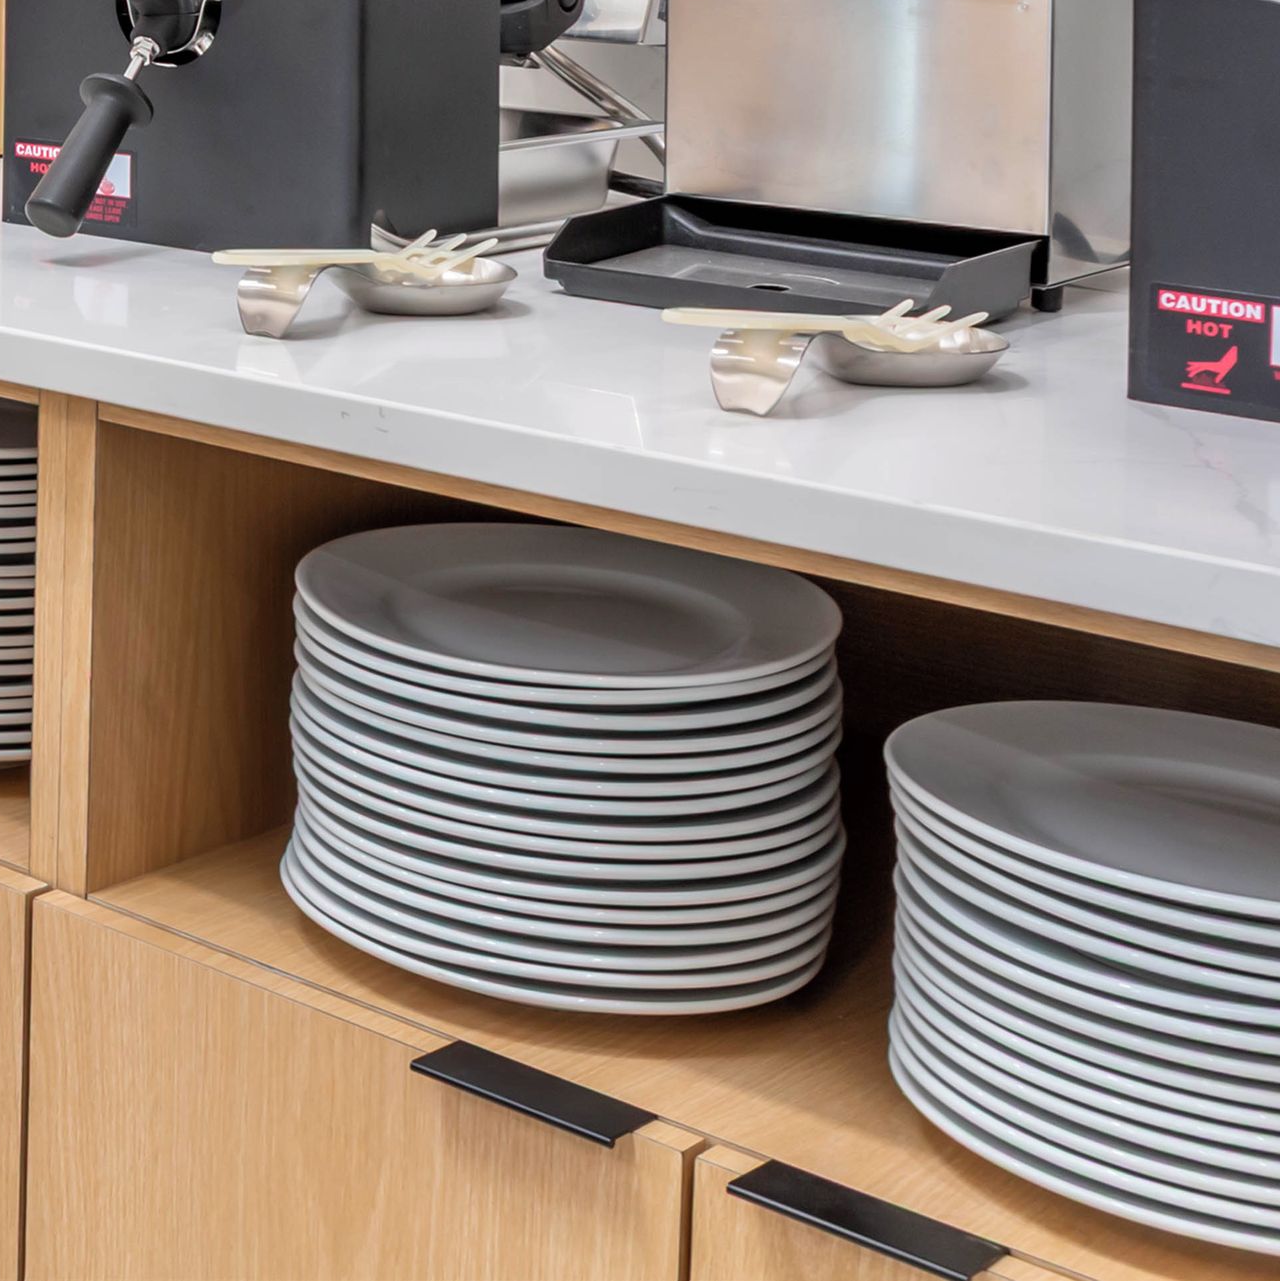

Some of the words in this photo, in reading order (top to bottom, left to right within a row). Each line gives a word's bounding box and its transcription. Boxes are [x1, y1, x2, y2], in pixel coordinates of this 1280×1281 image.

[16, 144, 60, 158] CAUTIO
[30, 161, 49, 175] HO
[1160, 293, 1261, 319] CAUTION
[1185, 319, 1233, 339] HOT
